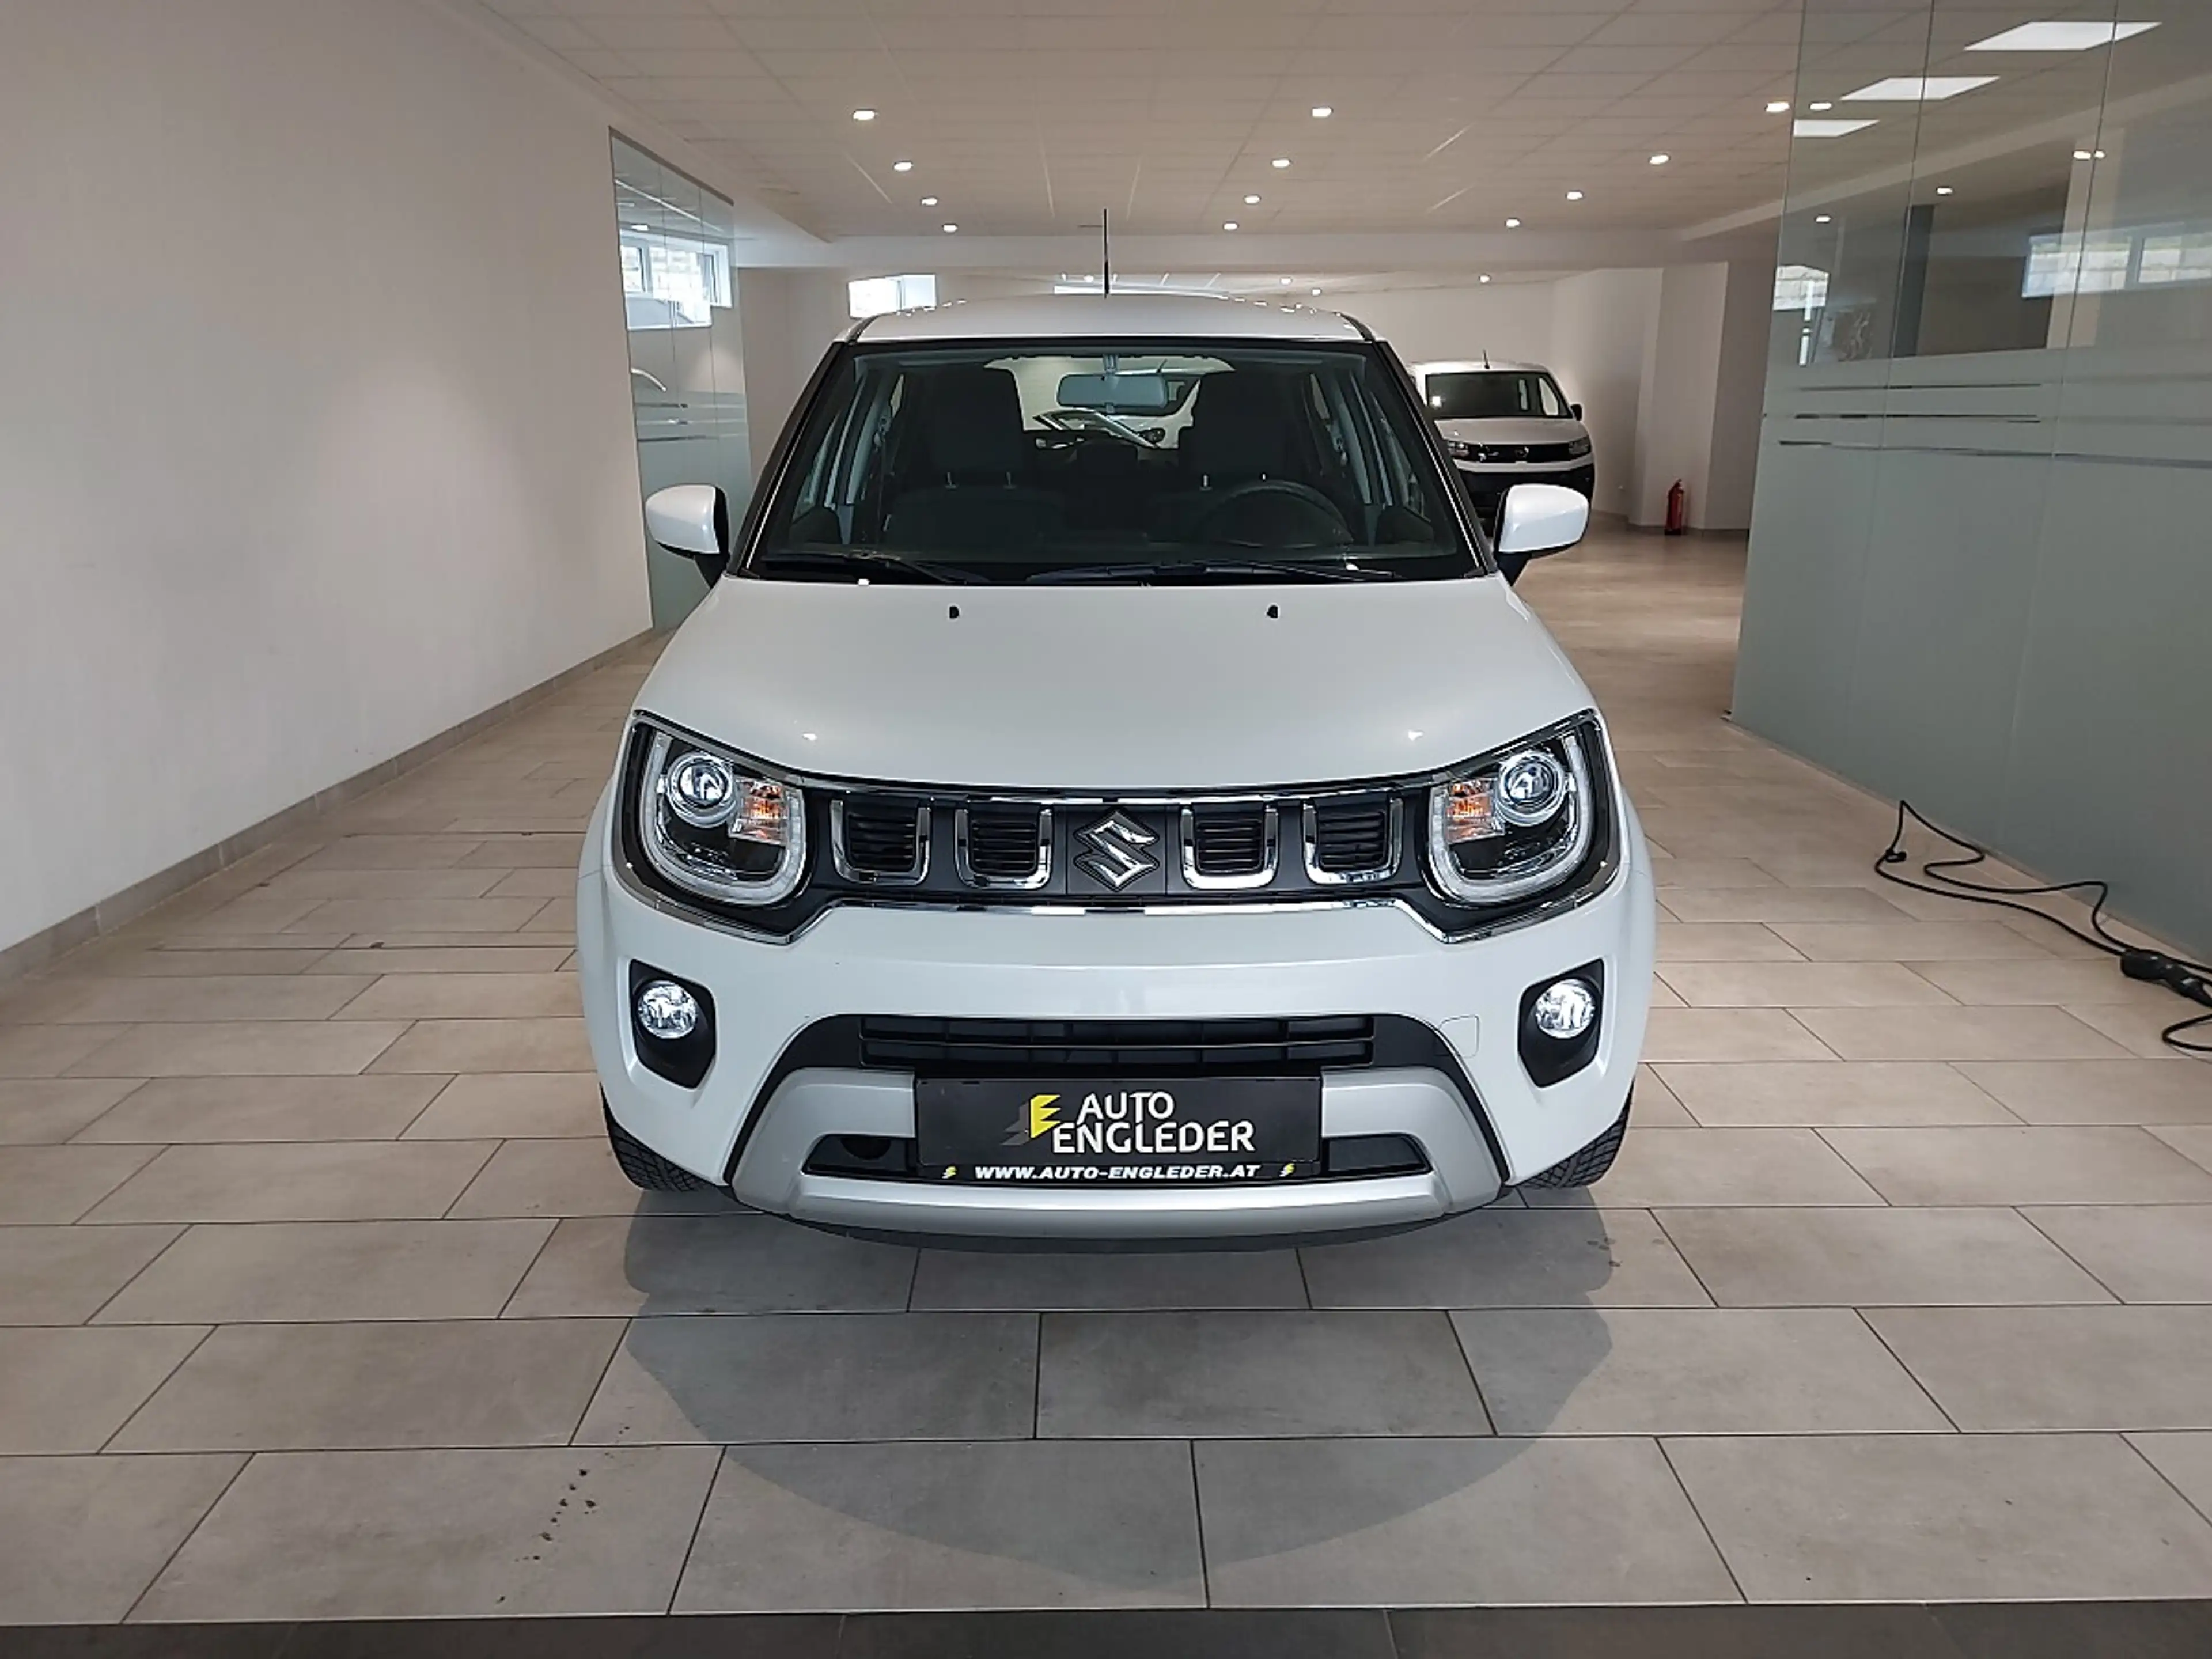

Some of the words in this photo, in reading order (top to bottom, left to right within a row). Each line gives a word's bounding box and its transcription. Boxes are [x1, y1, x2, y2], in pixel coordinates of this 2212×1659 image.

[1077, 1091, 1174, 1124] AUTO
[1053, 1121, 1256, 1153] ENGLEDER
[975, 1164, 1260, 1180] WWW.AUTO-ENGLEDER.AT
